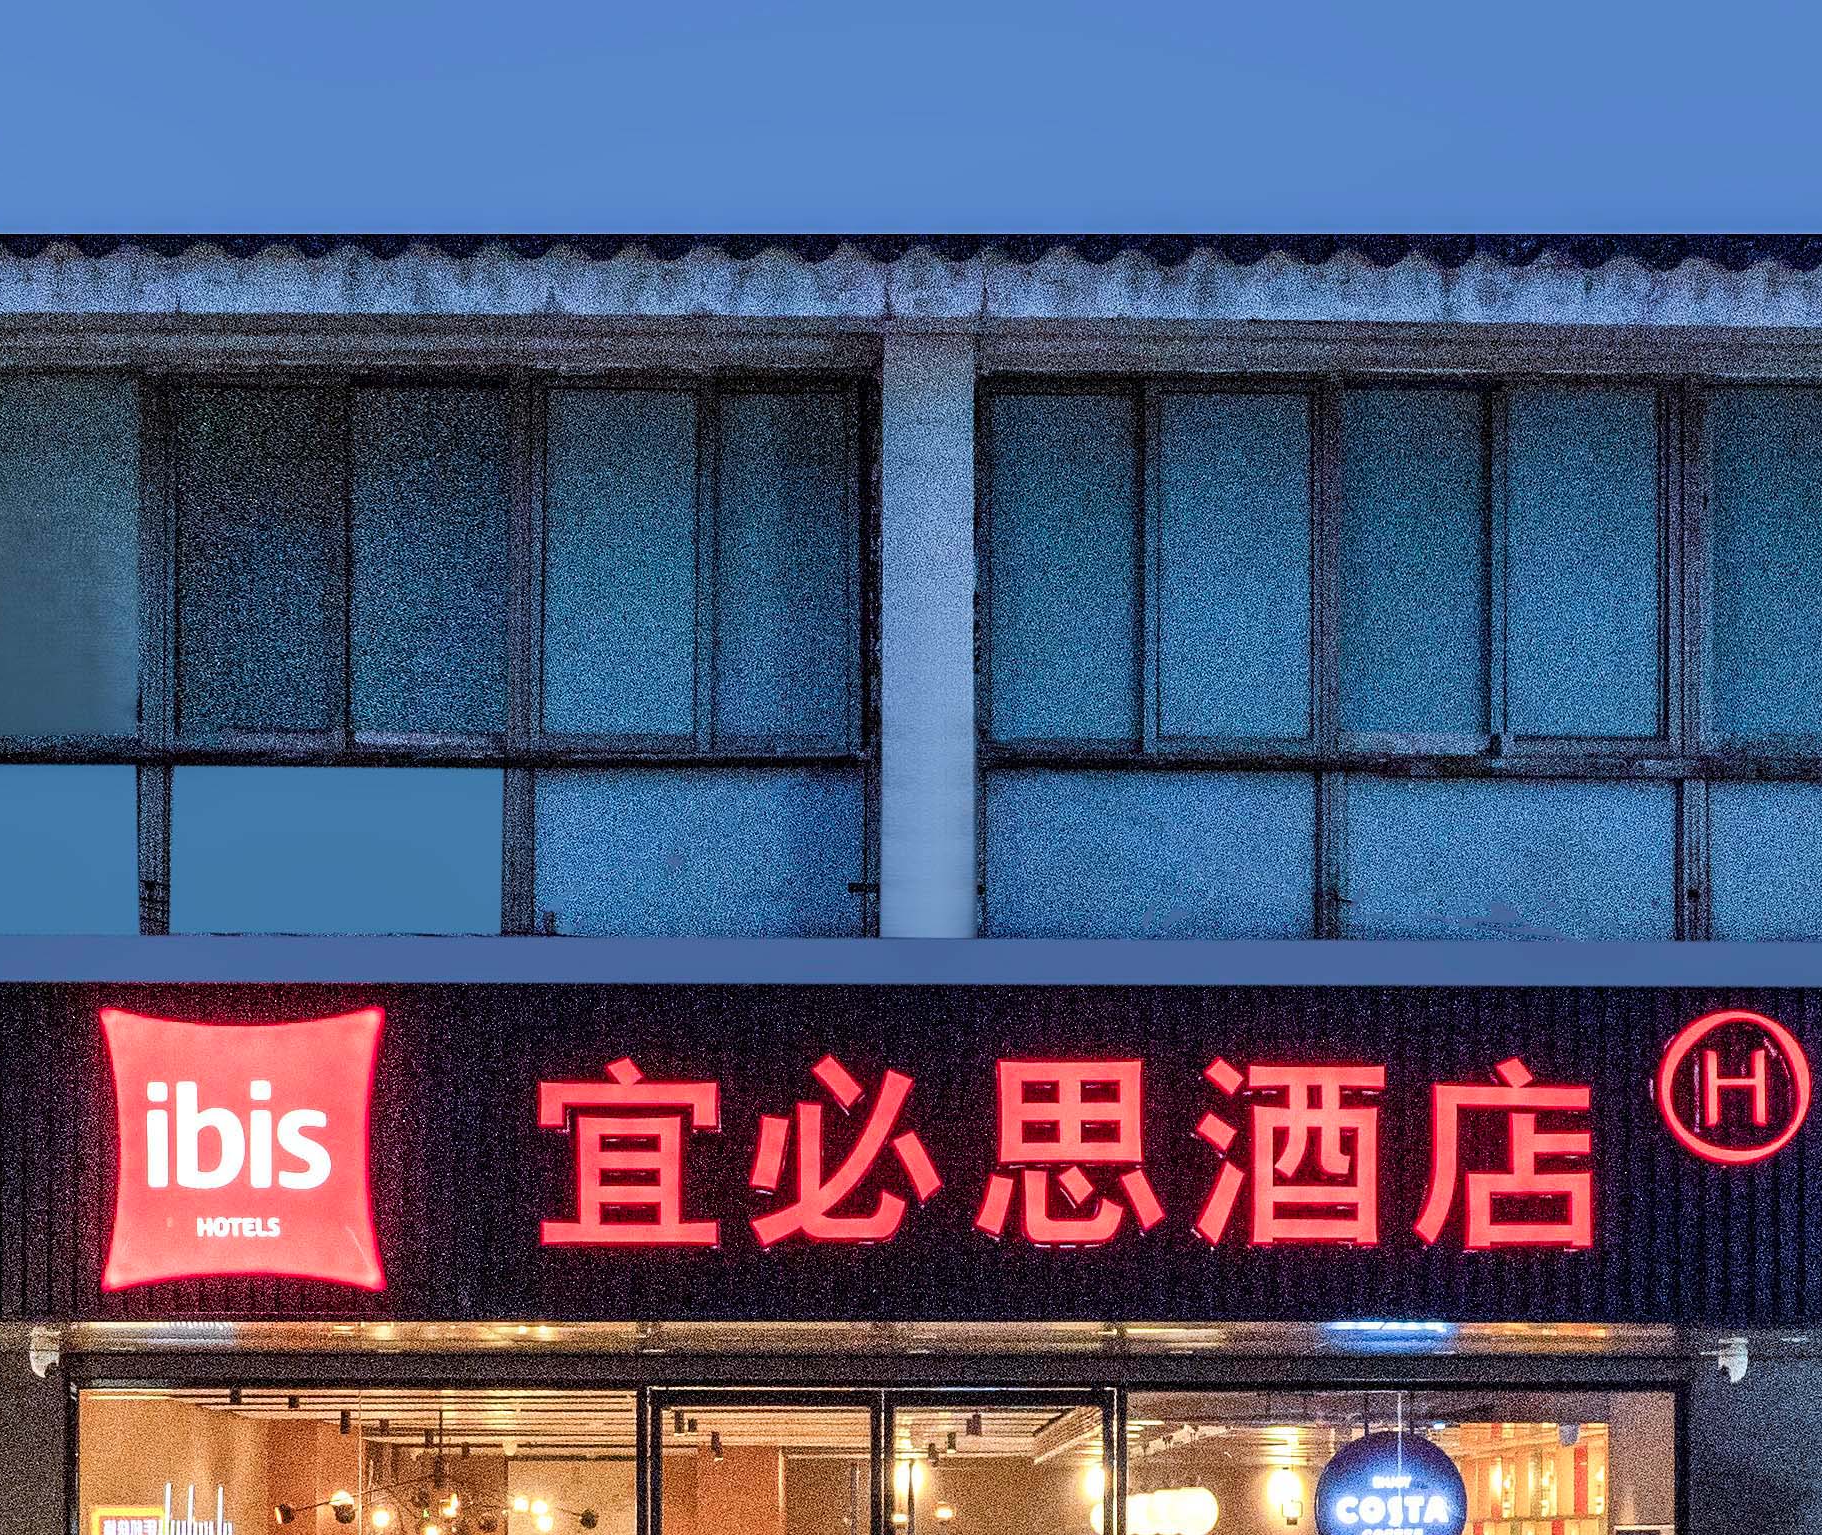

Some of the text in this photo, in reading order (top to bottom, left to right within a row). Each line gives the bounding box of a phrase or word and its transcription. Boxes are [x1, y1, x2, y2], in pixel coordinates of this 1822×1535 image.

[146, 1079, 332, 1190] ibis
[536, 1055, 1595, 1249] 宜必思酒店
[196, 1217, 281, 1238] HOTELS
[1336, 1495, 1449, 1528] COSTA
